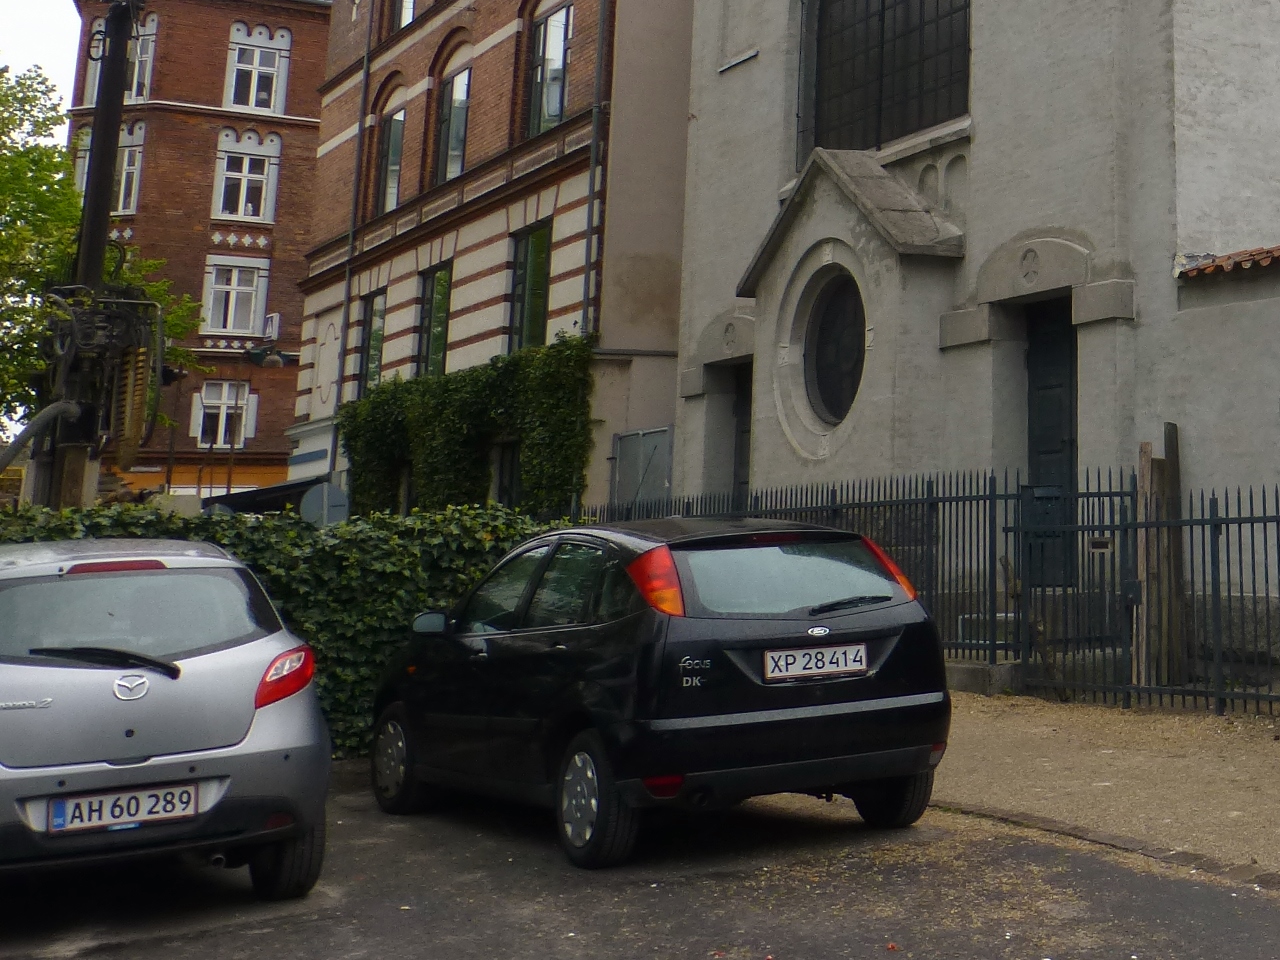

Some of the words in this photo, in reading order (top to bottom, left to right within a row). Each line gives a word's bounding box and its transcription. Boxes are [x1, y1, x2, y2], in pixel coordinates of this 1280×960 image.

[770, 654, 797, 674] XP
[802, 651, 826, 671] 28
[828, 648, 863, 668] 414
[682, 676, 701, 687] DK
[69, 800, 104, 825] AH
[110, 795, 141, 820] 60
[147, 790, 192, 815] 289
